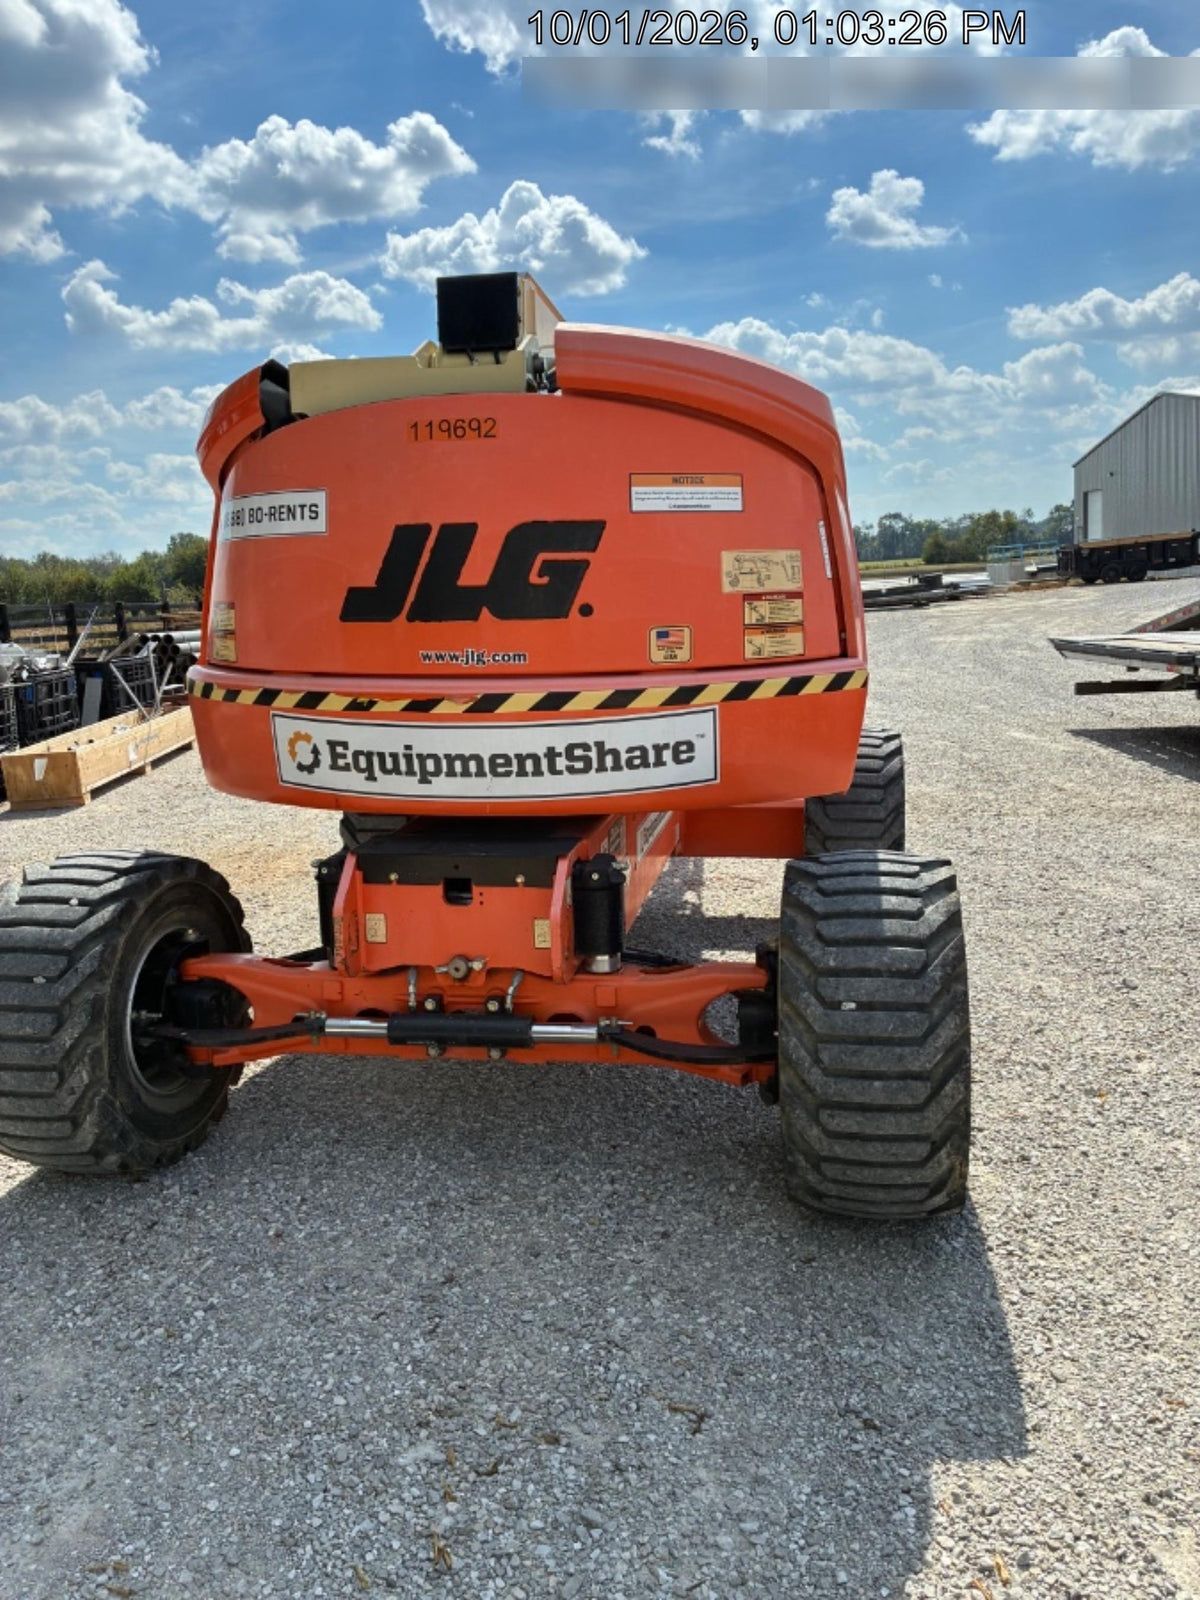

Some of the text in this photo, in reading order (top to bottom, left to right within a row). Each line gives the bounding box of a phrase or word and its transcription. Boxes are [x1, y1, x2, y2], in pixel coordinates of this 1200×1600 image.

[410, 417, 497, 441] 119692
[247, 502, 320, 524] BO-RENTS
[419, 648, 529, 667] www.jlg.com
